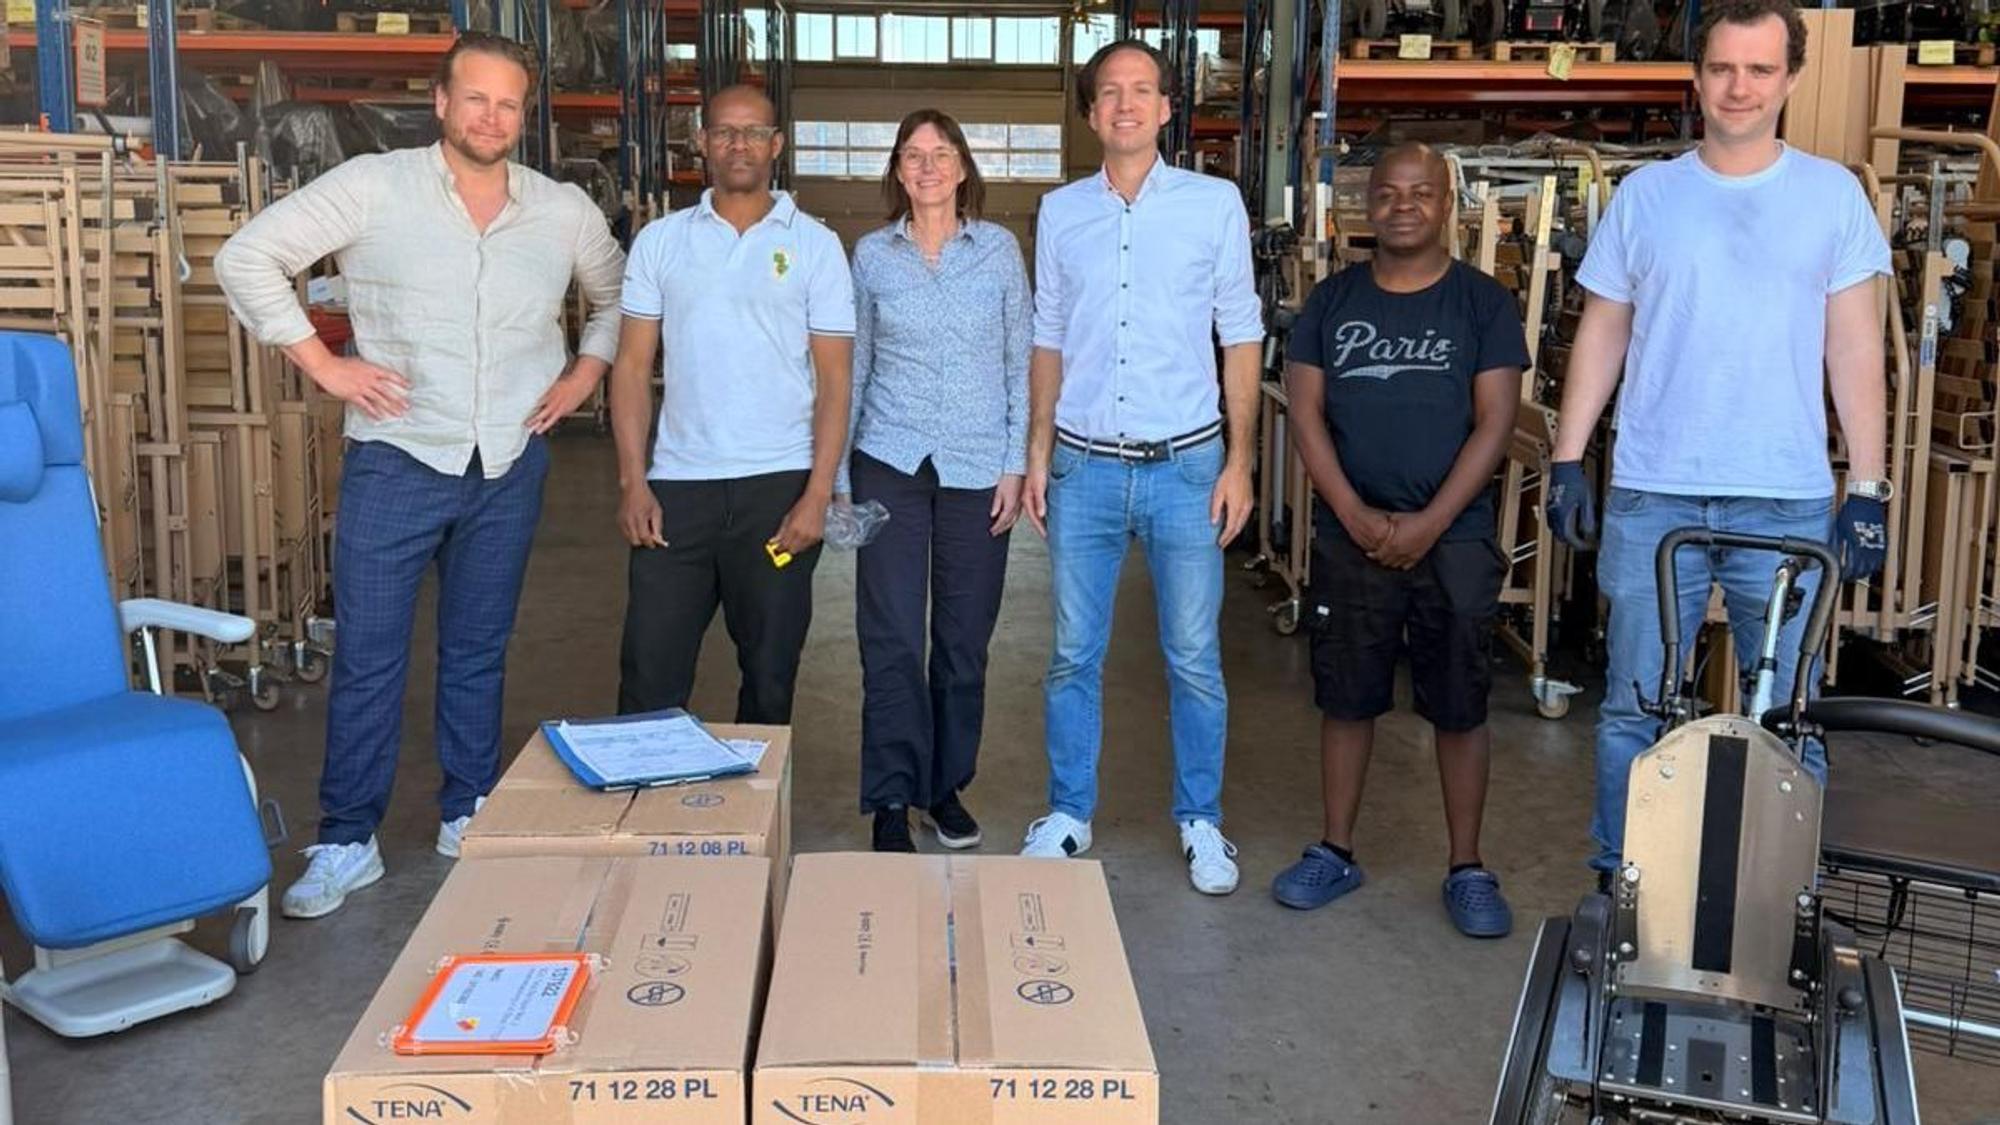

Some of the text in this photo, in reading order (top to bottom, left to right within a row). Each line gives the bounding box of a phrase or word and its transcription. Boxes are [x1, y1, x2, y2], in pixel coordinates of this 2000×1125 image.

[1333, 320, 1457, 367] Paris
[648, 841, 751, 856] 71 12 08 PL
[569, 1079, 718, 1100] 71 12 28 PL
[990, 1079, 1135, 1099] 71 12 28 PL
